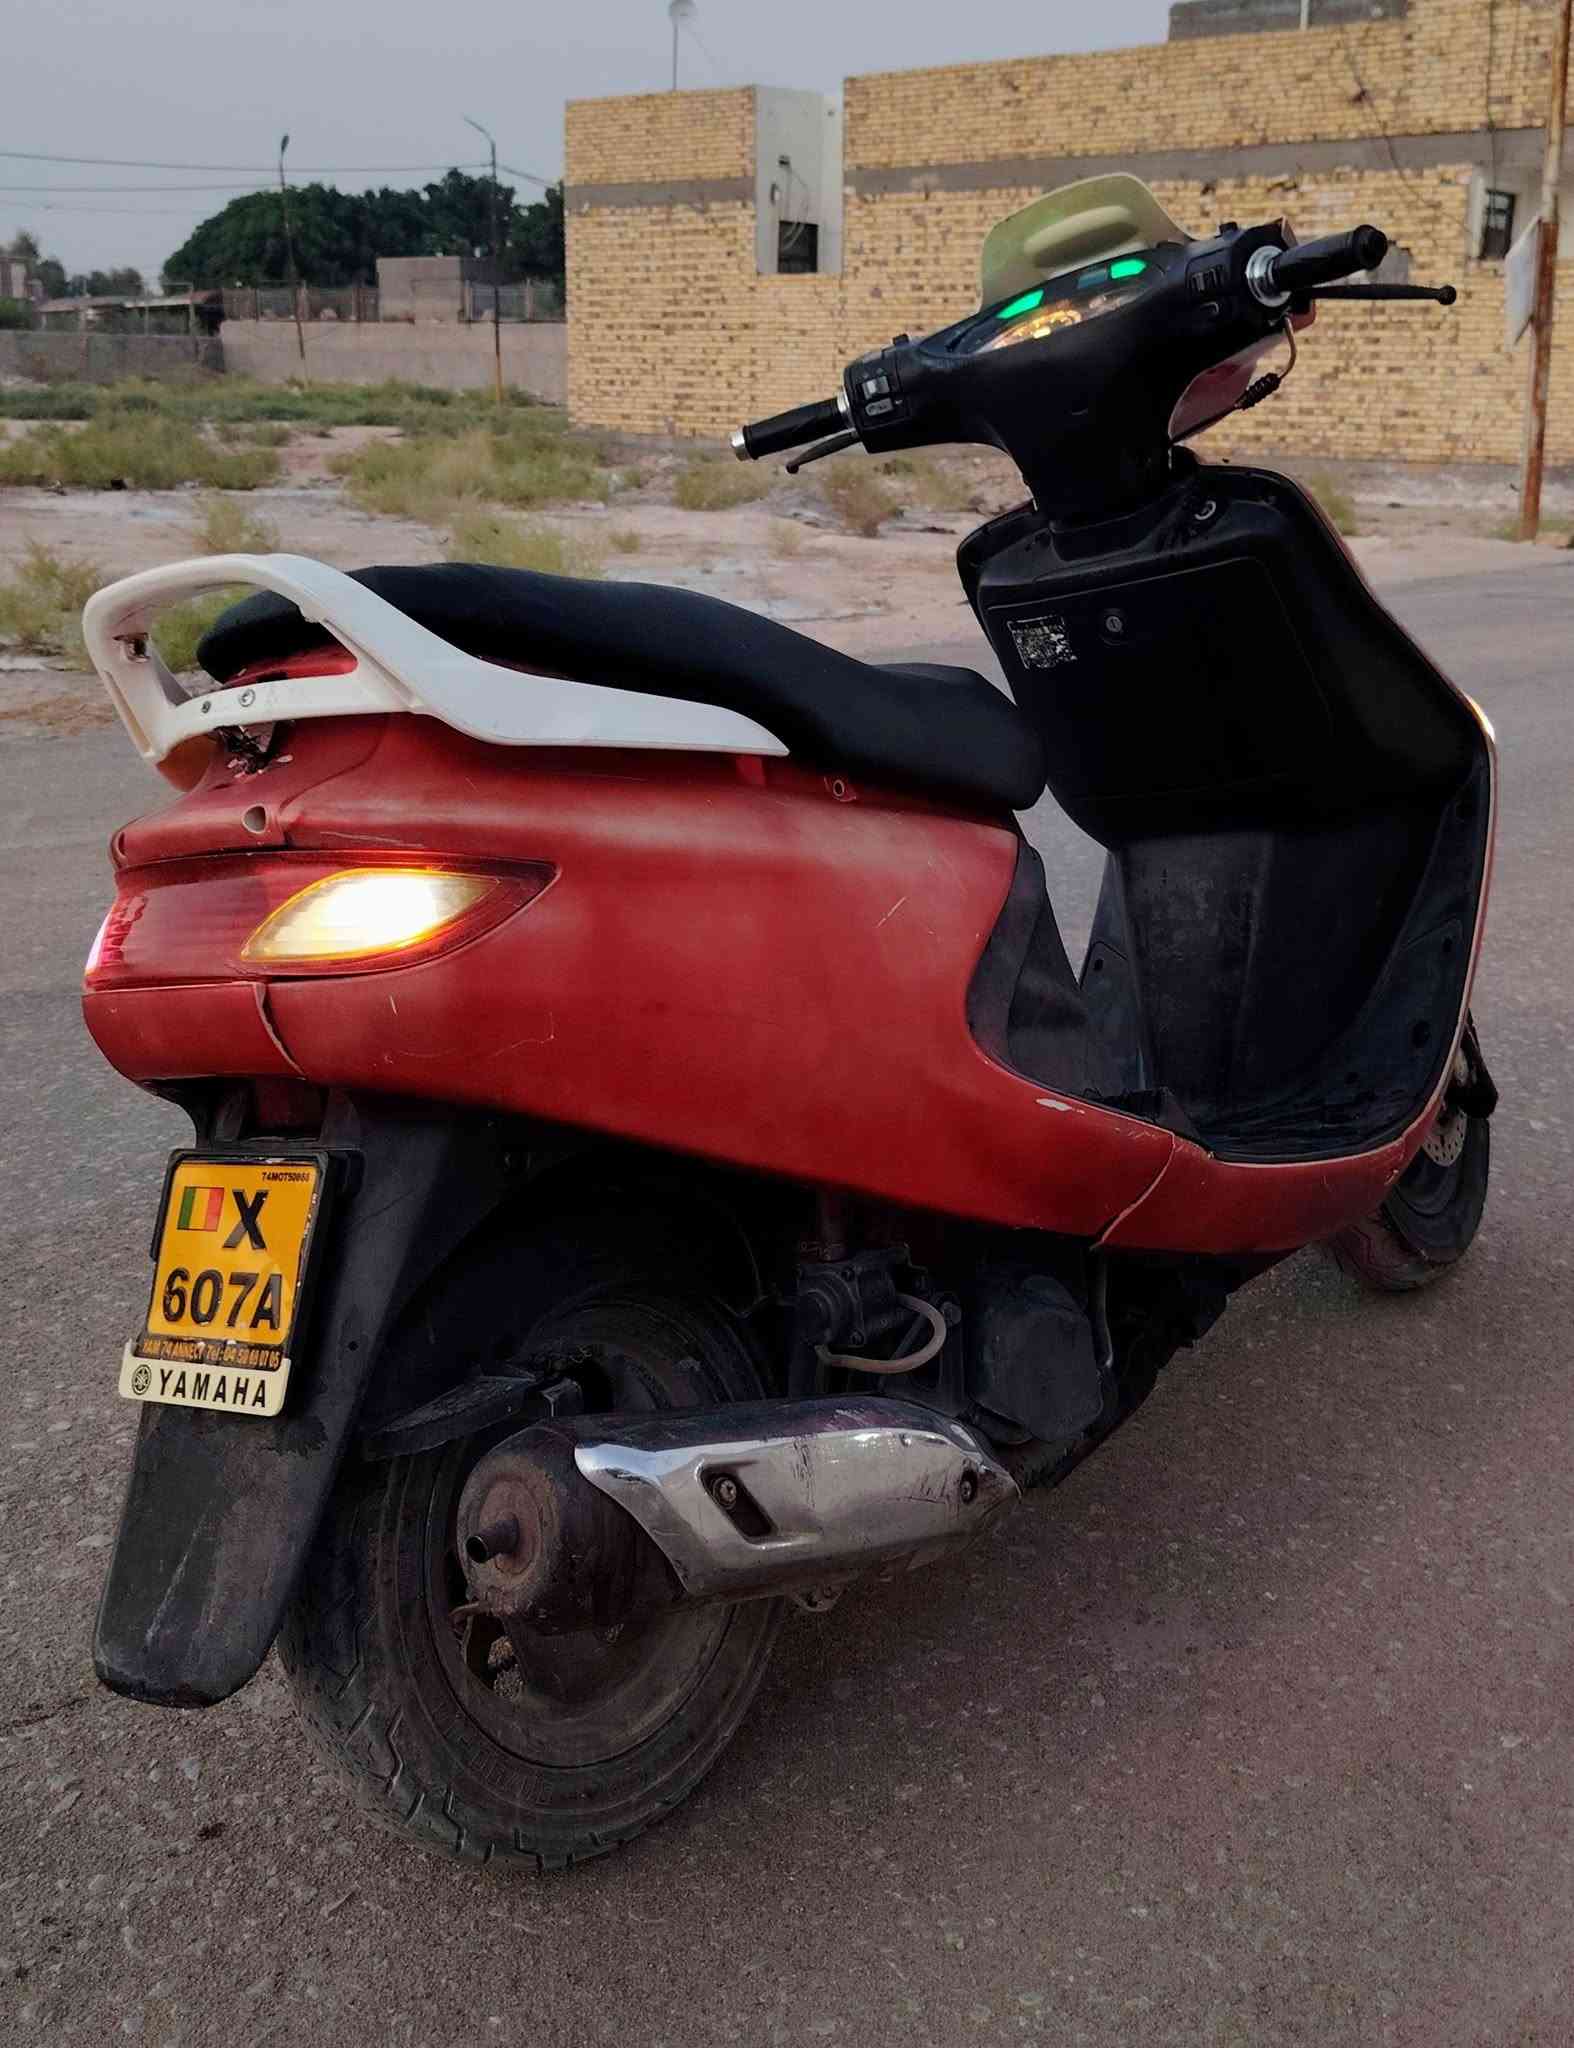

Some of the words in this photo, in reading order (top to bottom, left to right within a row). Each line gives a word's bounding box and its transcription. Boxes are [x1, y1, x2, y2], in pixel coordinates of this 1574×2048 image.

[223, 1189, 268, 1249] X
[163, 1267, 282, 1329] 607A
[159, 1369, 266, 1408] YAMAHA
